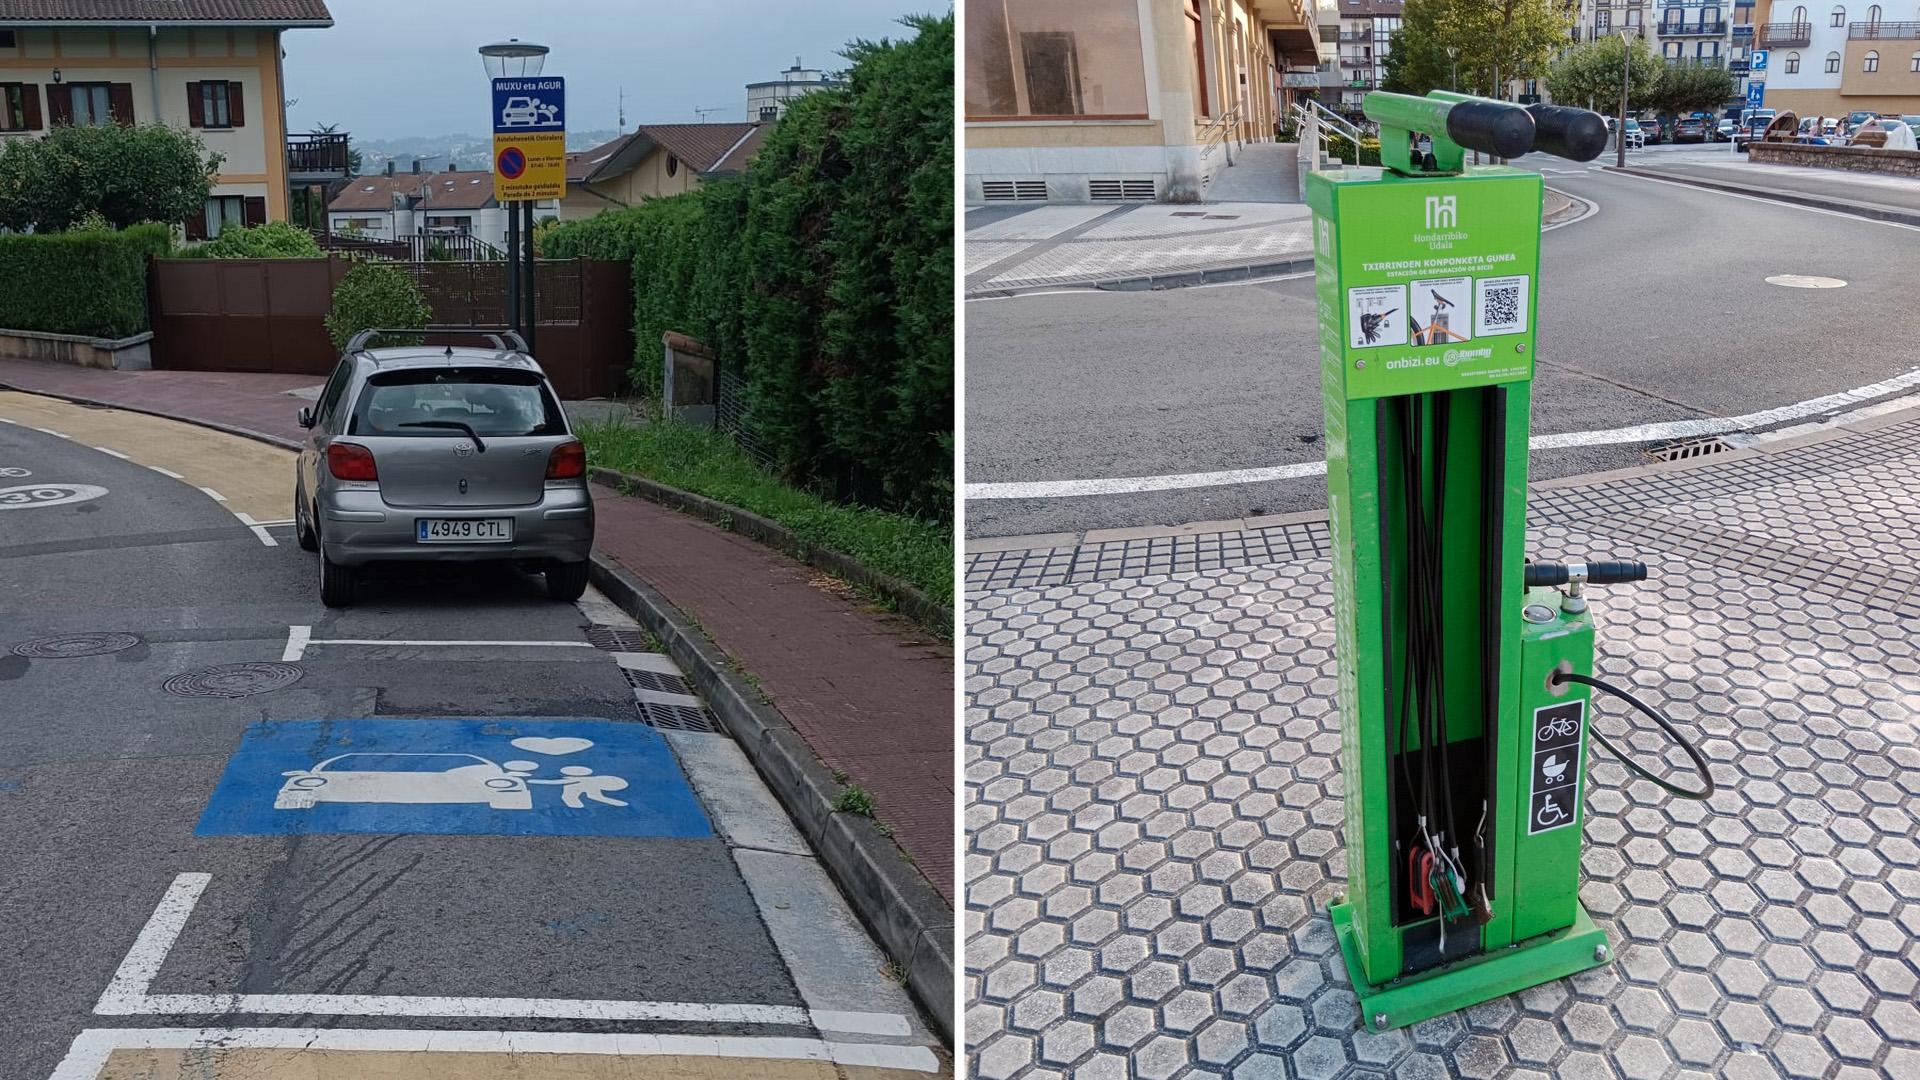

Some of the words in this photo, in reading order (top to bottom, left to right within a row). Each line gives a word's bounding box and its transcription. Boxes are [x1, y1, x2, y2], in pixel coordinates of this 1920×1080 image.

[496, 82, 522, 92] MUXU
[523, 83, 537, 91] eta
[538, 81, 562, 91] AGUR
[1414, 231, 1468, 243] Hondarribiko
[1430, 240, 1453, 249] Udala
[1362, 260, 1421, 271] TXIRRINDEN
[1424, 256, 1484, 268] KONPONKETA
[1486, 253, 1516, 263] GUNEA
[1386, 355, 1440, 369] onbizi.eu
[431, 521, 471, 537] 4949
[477, 521, 505, 537] CTL
